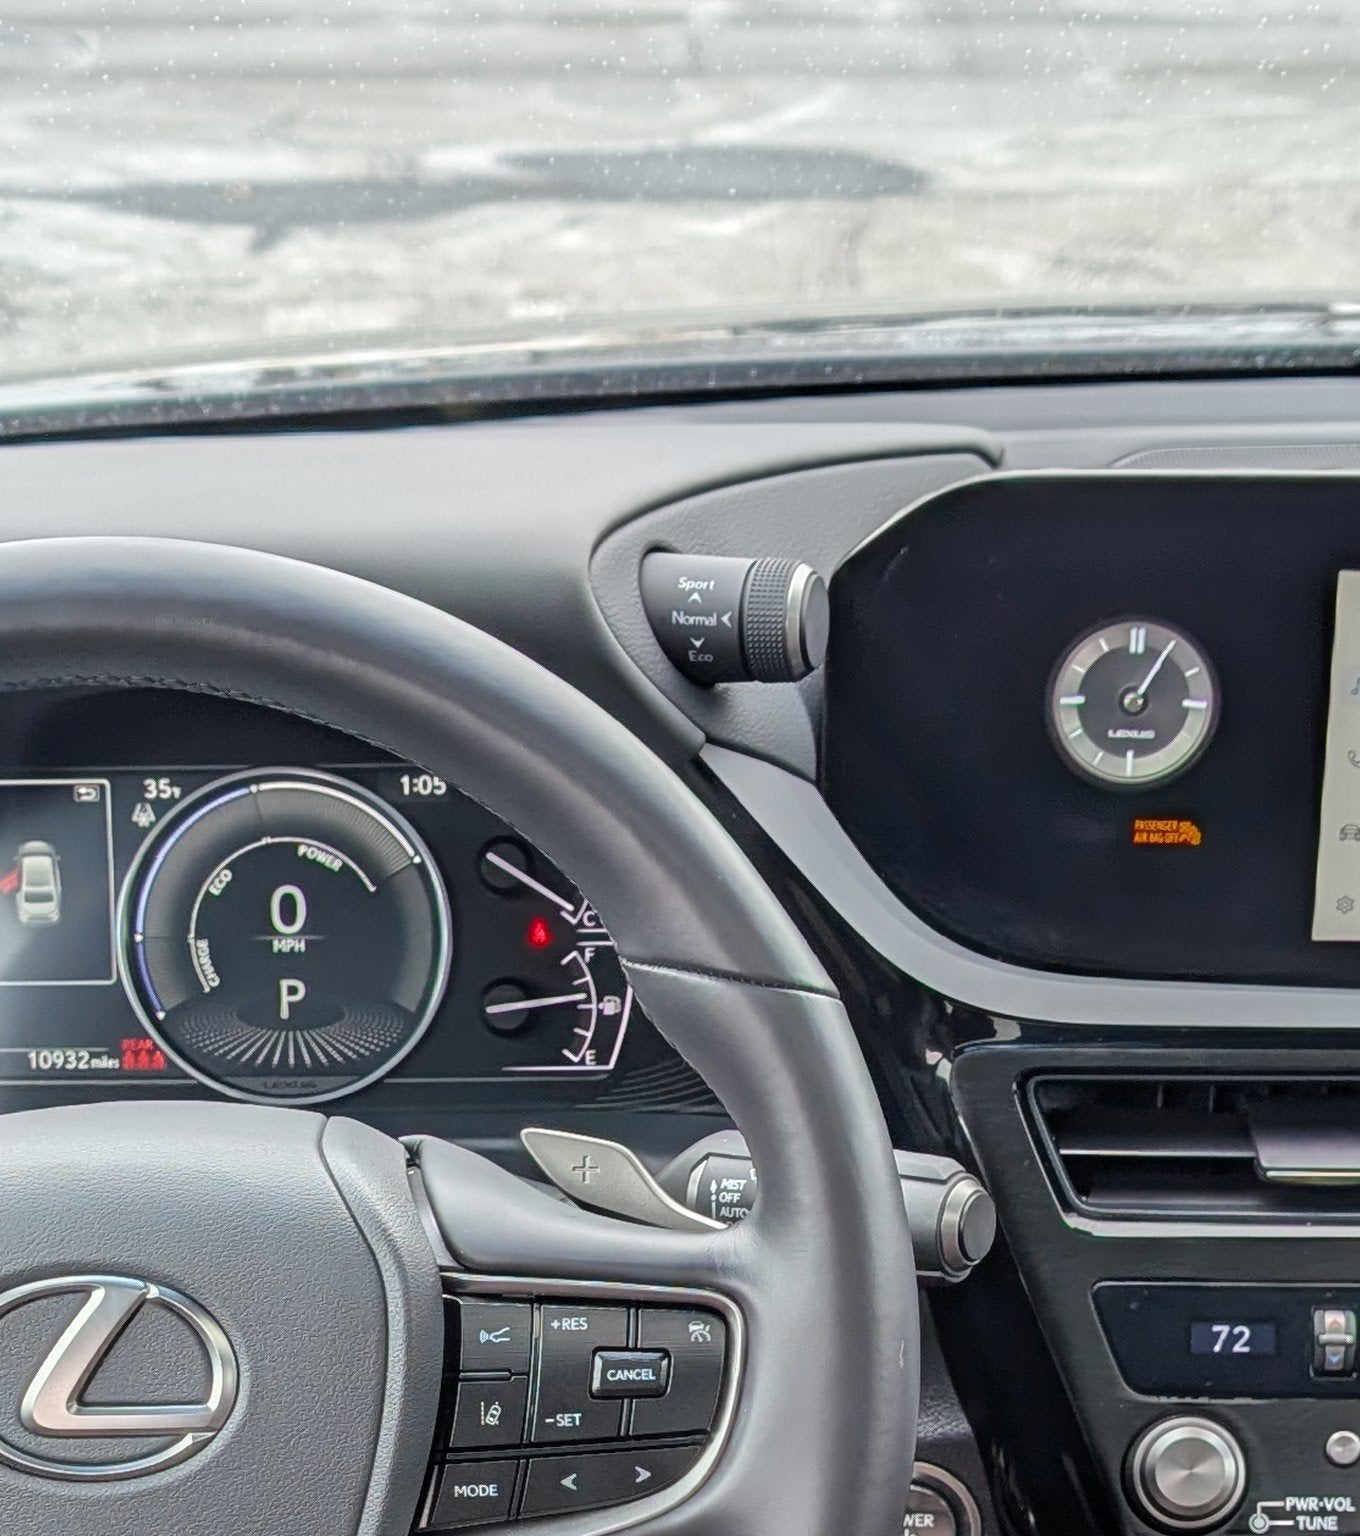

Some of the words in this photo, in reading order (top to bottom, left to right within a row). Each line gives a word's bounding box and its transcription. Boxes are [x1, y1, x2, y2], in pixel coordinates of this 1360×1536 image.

[678, 576, 715, 593] Sport
[672, 611, 717, 626] Normal
[688, 650, 713, 662] Eco
[399, 774, 447, 795] 1:05
[296, 844, 343, 873] POWER
[208, 868, 233, 896] ECO
[269, 884, 307, 934] 0
[272, 938, 307, 953] MPH
[195, 937, 221, 988] CHARGE
[279, 978, 307, 1020] P
[28, 1050, 90, 1070] 10932
[90, 1056, 120, 1070] miles
[720, 1178, 748, 1191] MIST
[718, 1191, 742, 1204] OFF
[1210, 1324, 1252, 1353] 72
[606, 1367, 656, 1381] CANCEL
[453, 1483, 499, 1498] MODE
[1296, 1515, 1338, 1531] TUNE
